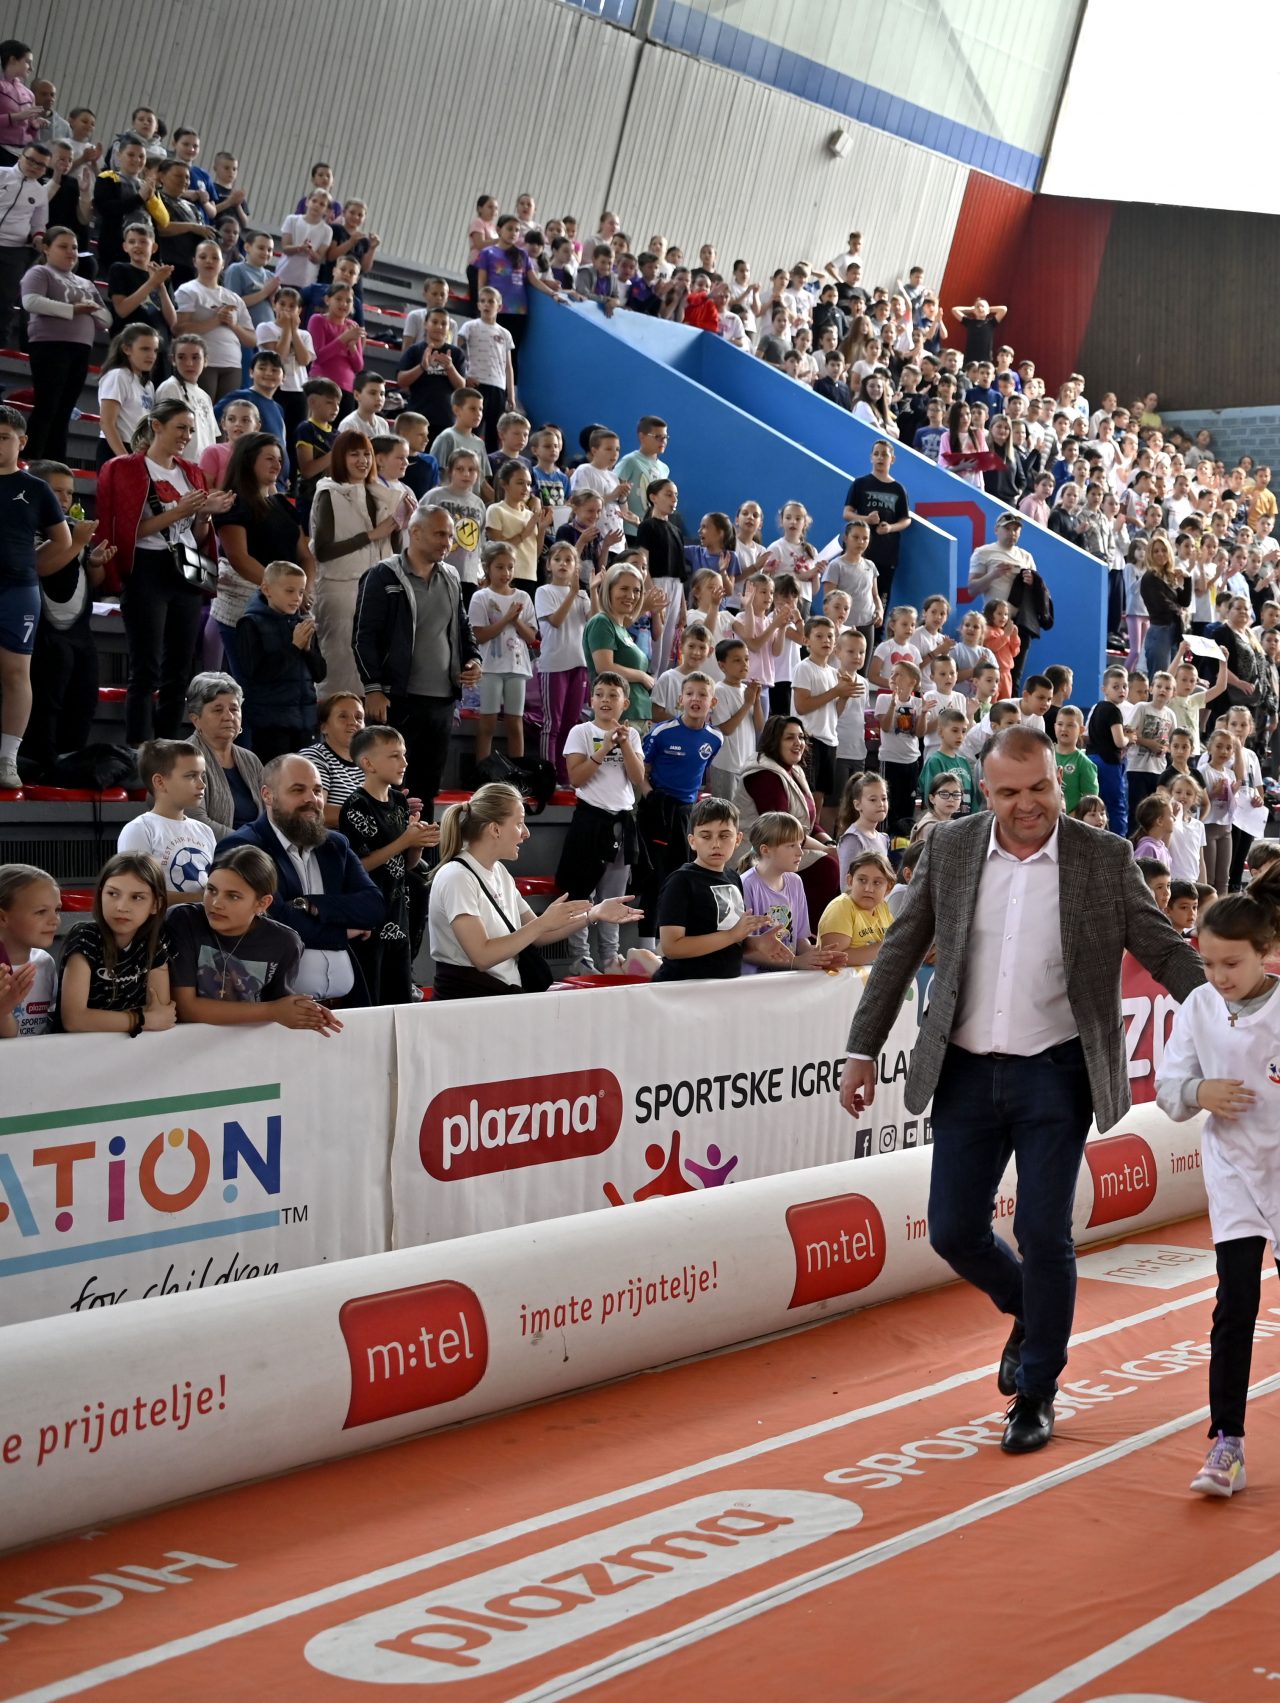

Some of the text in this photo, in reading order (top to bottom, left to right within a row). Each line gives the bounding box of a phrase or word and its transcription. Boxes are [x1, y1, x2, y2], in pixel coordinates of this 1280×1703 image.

[23, 621, 34, 643] 7
[161, 836, 206, 866] BEST FAIR PLAY
[28, 1004, 48, 1013] plazm
[635, 1068, 783, 1125] SPORTSKE
[791, 1057, 845, 1100] IGRE
[442, 1094, 598, 1170] plazma
[1100, 1149, 1202, 1199] m:tel imat
[805, 1217, 876, 1275] m:tel
[1104, 1250, 1207, 1280] m:tel
[366, 1261, 719, 1383] m:tel imate prijatelje!
[37, 1374, 228, 1467] prijatelje!
[375, 1504, 794, 1667] plazma
